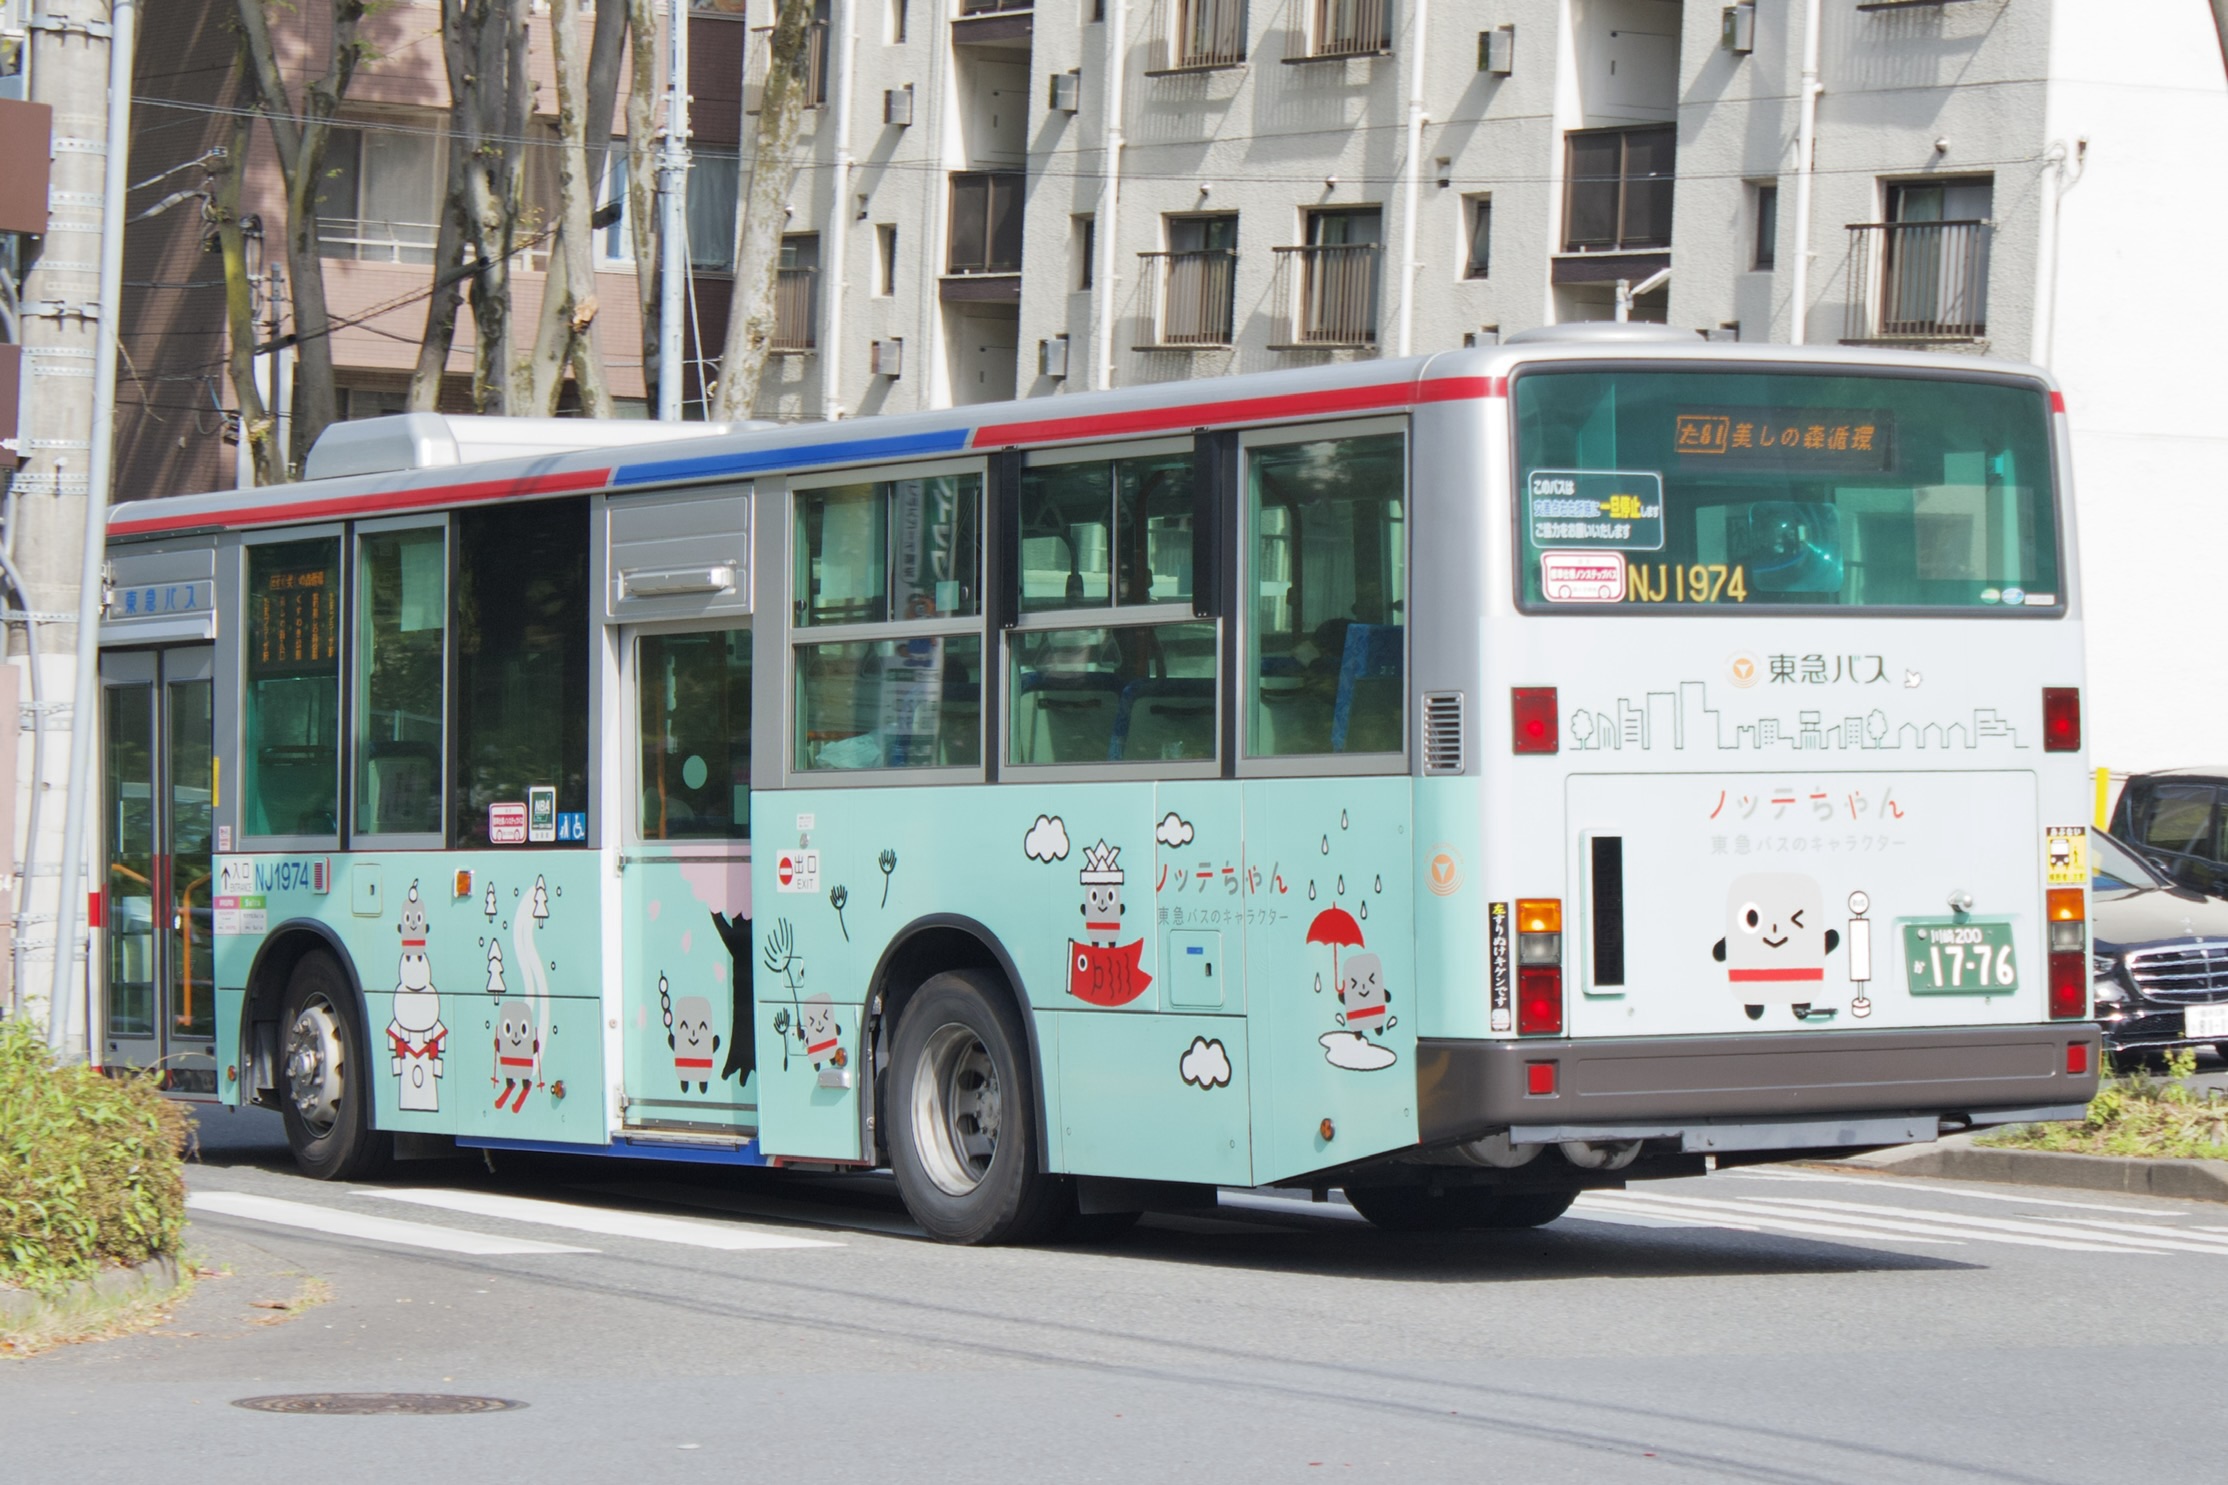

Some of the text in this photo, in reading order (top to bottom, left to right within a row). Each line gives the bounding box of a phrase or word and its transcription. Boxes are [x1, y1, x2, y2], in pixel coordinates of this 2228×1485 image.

[1732, 423, 1875, 450] 美しの森循環
[1533, 480, 1575, 495] このバスは
[1628, 564, 1747, 602] NJ1974
[125, 585, 196, 614] 東急バス
[1768, 654, 1890, 684] 東急バス
[1710, 786, 1904, 821] ノッテちゃん
[1711, 835, 1906, 855] 東急バスのキャラクター
[233, 863, 249, 879] 入口
[256, 861, 308, 891] NJ1974
[794, 854, 816, 874] 出口
[1157, 860, 1288, 895] ノッテちゃん
[797, 879, 813, 889] EXIT
[1158, 906, 1288, 925] 東急バスのキャラクター
[1930, 928, 1983, 944] 川崎200
[1492, 903, 1508, 1007] 左すりぬけキケンです
[1930, 944, 2015, 987] 17-76
